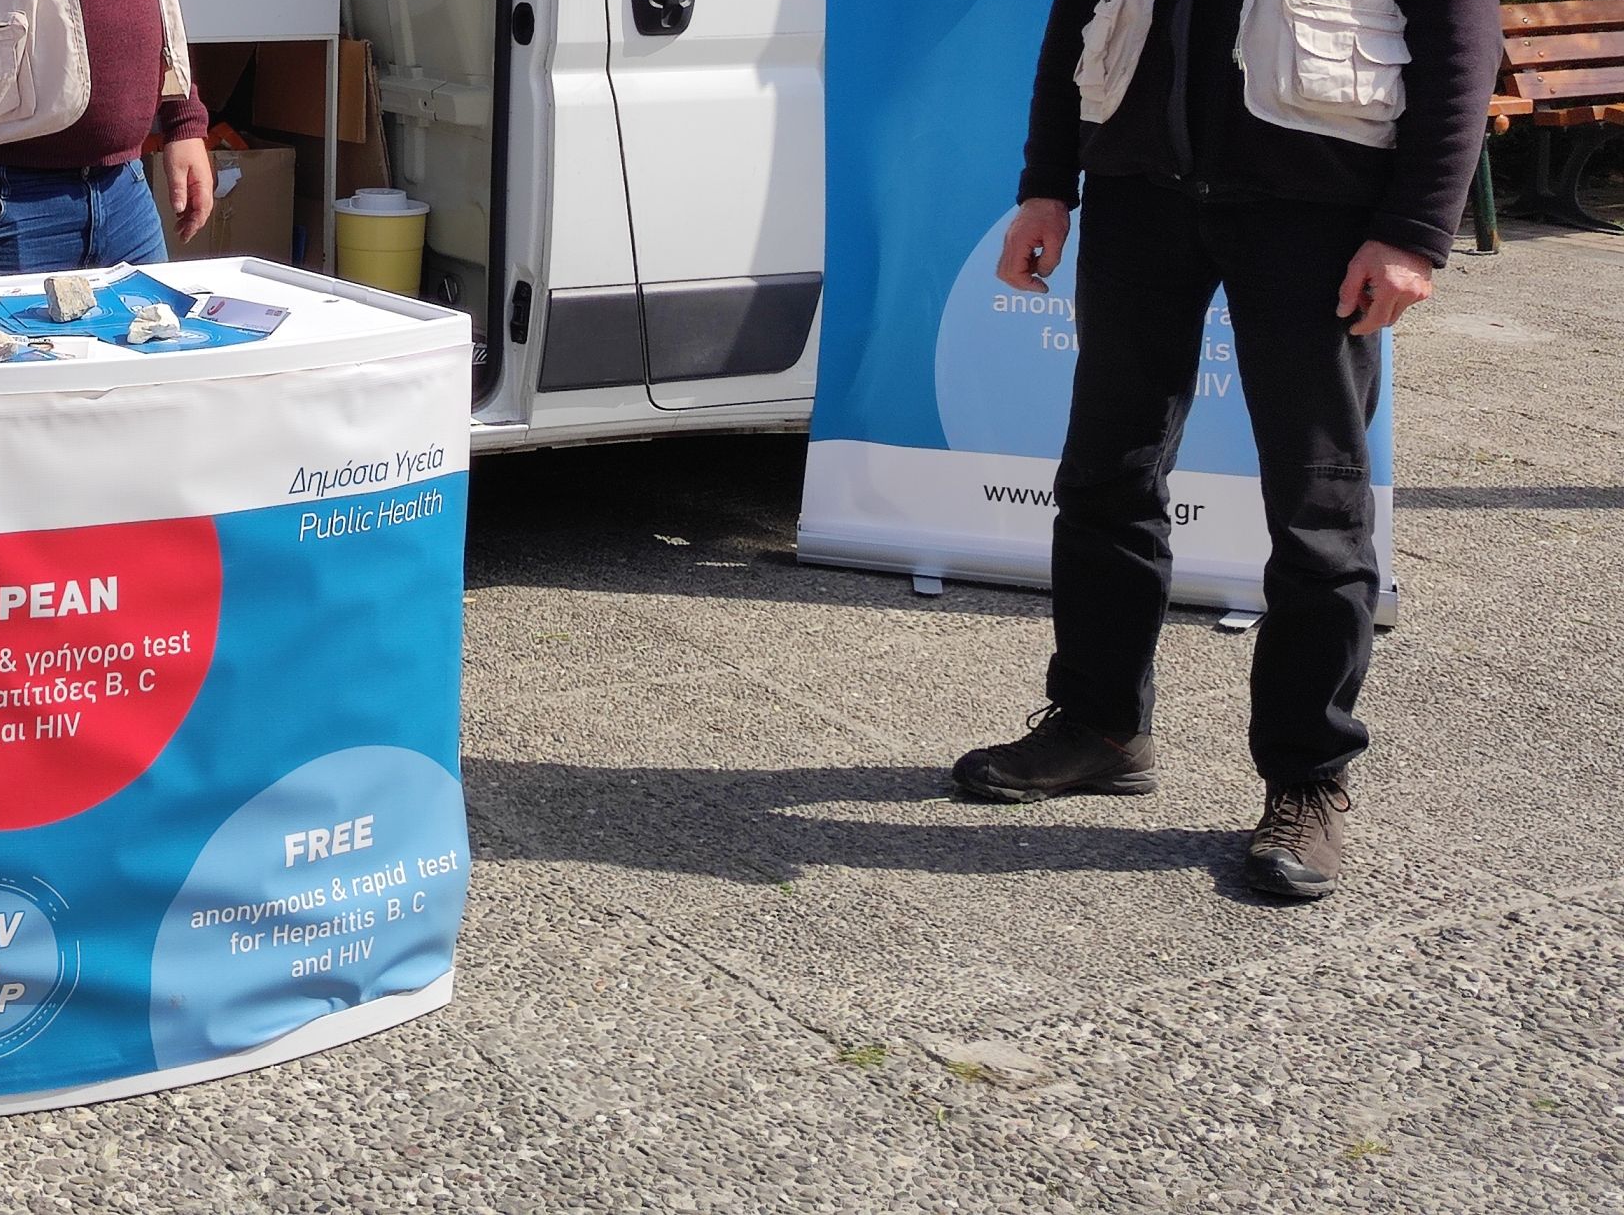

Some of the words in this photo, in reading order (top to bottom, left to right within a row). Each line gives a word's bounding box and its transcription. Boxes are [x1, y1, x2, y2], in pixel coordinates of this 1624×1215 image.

[992, 293, 1076, 323] anony
[288, 460, 389, 497] Δημόσια
[395, 443, 445, 480] Υγεία
[299, 505, 373, 542] Public
[377, 488, 443, 528] Health
[25, 642, 135, 677] γρήγορο
[142, 630, 192, 658] test
[105, 672, 130, 698] B,
[139, 669, 156, 692] C
[34, 712, 82, 741] HIV
[284, 814, 375, 868] FREE
[190, 889, 326, 928] anonymous
[332, 878, 349, 901] &
[351, 861, 407, 896] rapid
[417, 850, 458, 878] test
[229, 931, 265, 955] for
[272, 910, 376, 947] Hepatitis
[386, 897, 406, 922] B,
[412, 890, 426, 913] C
[290, 949, 332, 978] and
[338, 937, 375, 965] HIV
